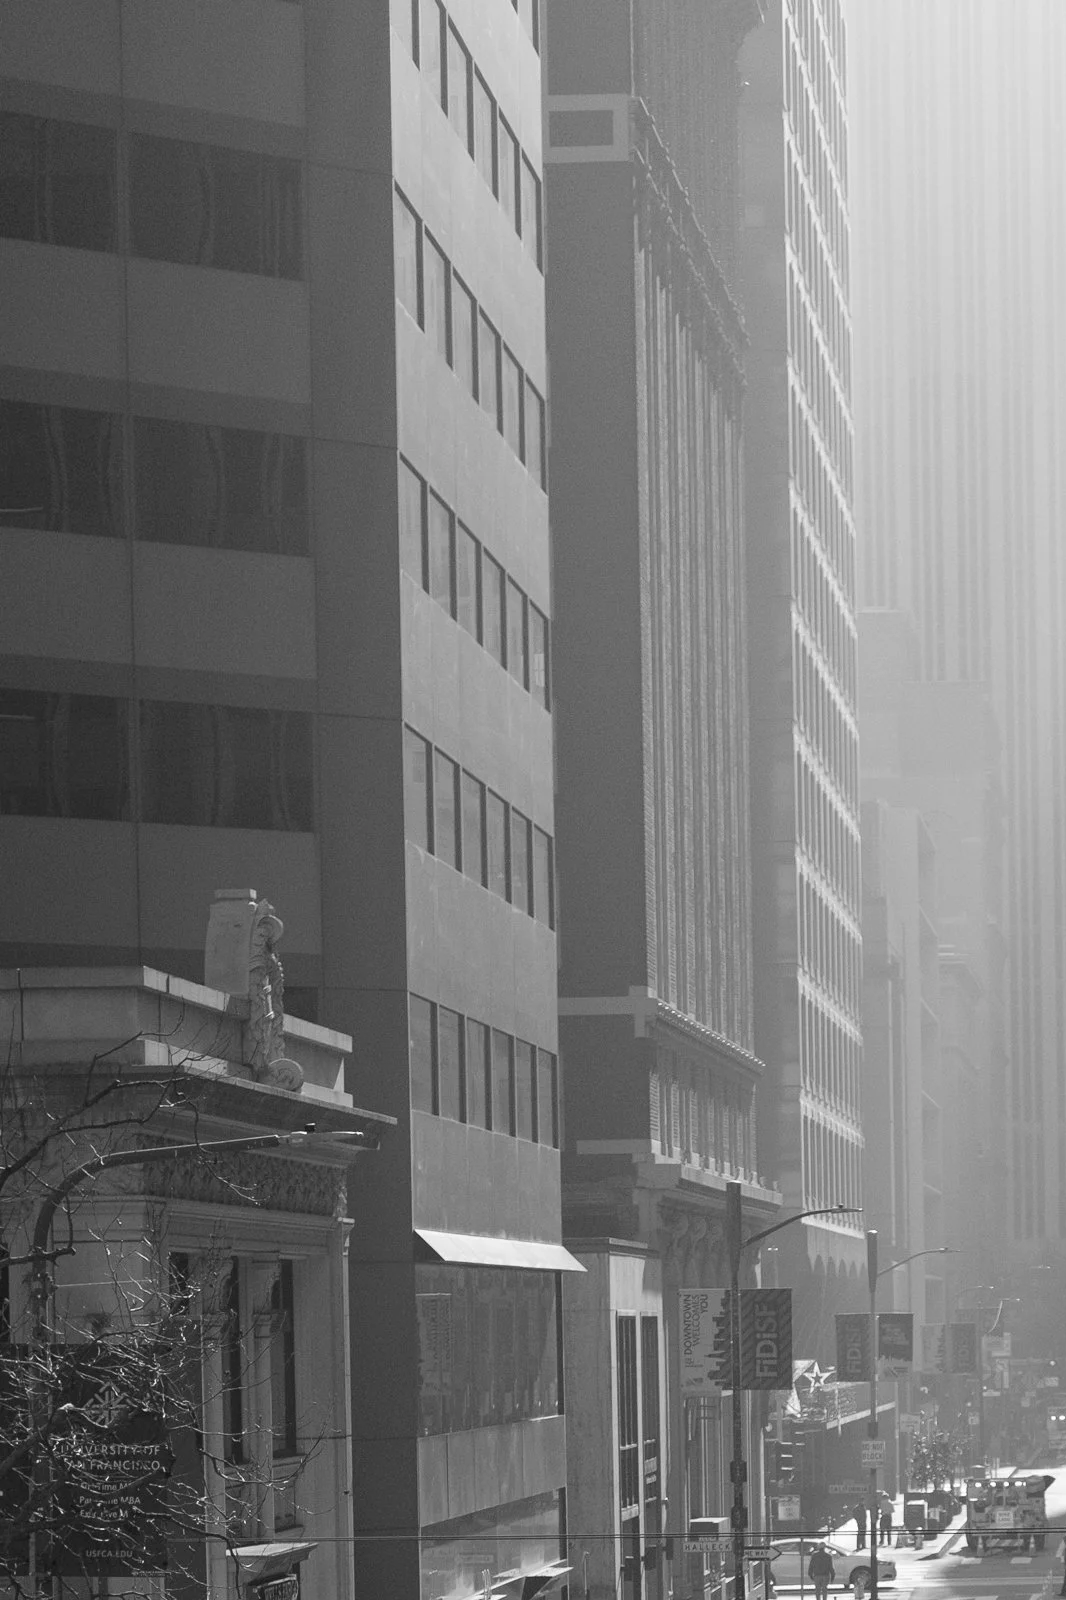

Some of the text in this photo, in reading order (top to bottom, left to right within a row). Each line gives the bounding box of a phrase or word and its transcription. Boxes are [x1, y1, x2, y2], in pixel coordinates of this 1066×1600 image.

[691, 1294, 701, 1347] WELCOMES
[700, 1294, 709, 1314] YOU
[683, 1294, 692, 1355] DOWNTOWN
[684, 1543, 731, 1551] HALLECK
